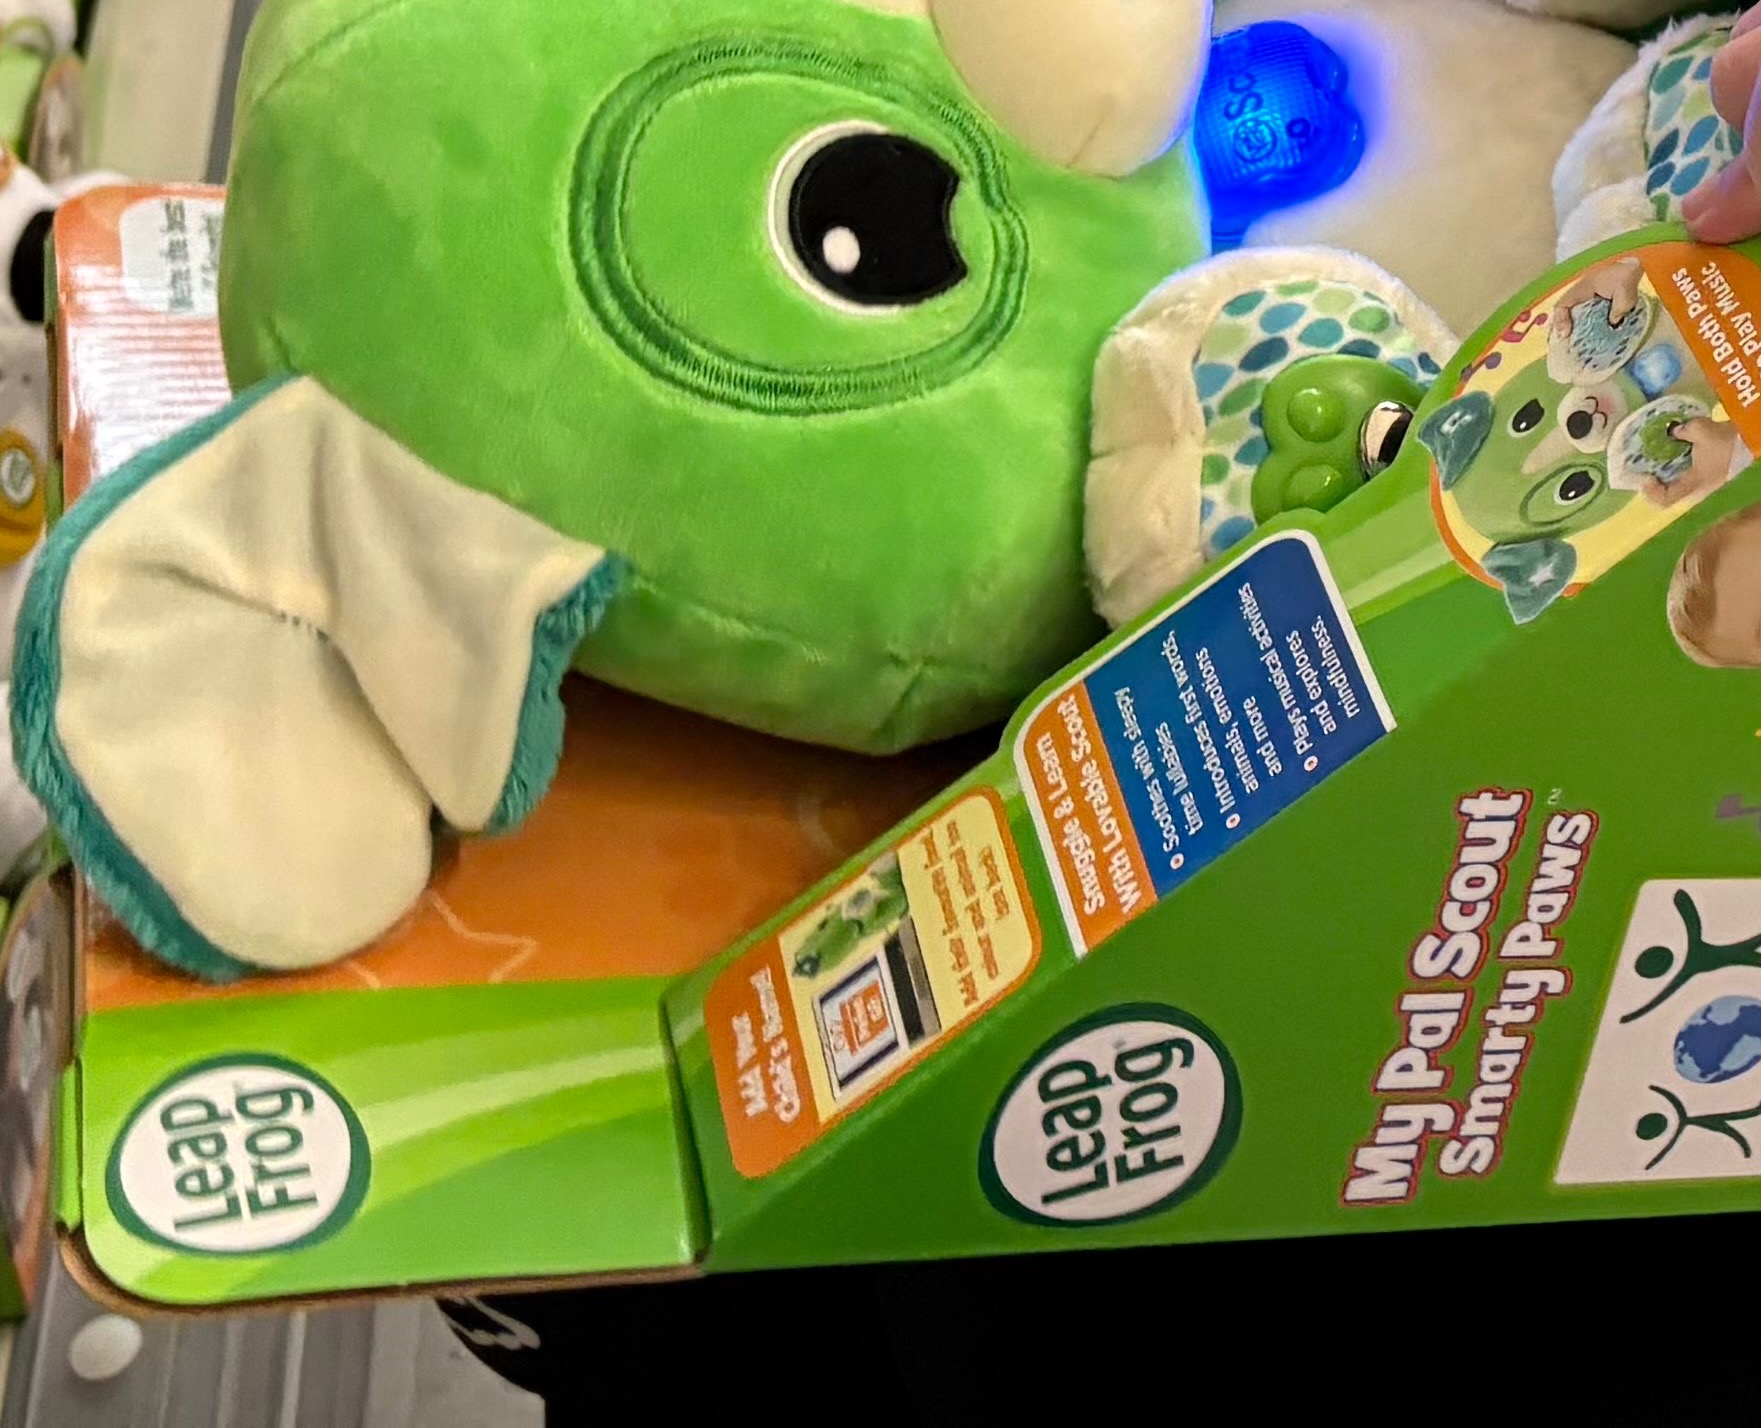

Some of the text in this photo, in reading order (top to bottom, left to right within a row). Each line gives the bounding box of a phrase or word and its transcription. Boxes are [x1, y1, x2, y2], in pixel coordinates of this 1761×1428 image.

[1671, 267, 1761, 408] Hold Both Paws
[1701, 261, 1741, 316] Music
[1160, 629, 1237, 815] Introduces first words,
[1195, 646, 1260, 795] animals, emotions
[1237, 581, 1314, 756] Plays musical activities
[1243, 695, 1283, 778] and more
[1285, 629, 1338, 735] and explores
[1311, 614, 1361, 719] mindfulness.
[1037, 732, 1106, 916] Snuggle & Learn
[1057, 693, 1143, 915] With Lovable Scout
[1114, 686, 1181, 853] Soothes with sleepy
[1155, 721, 1205, 836] time lullabies
[1341, 787, 1530, 1205] My Pal Scout
[1438, 810, 1595, 1178] Smarty Paws
[160, 1084, 319, 1233] Leap Frog
[1037, 1035, 1197, 1207] Leap Frog
